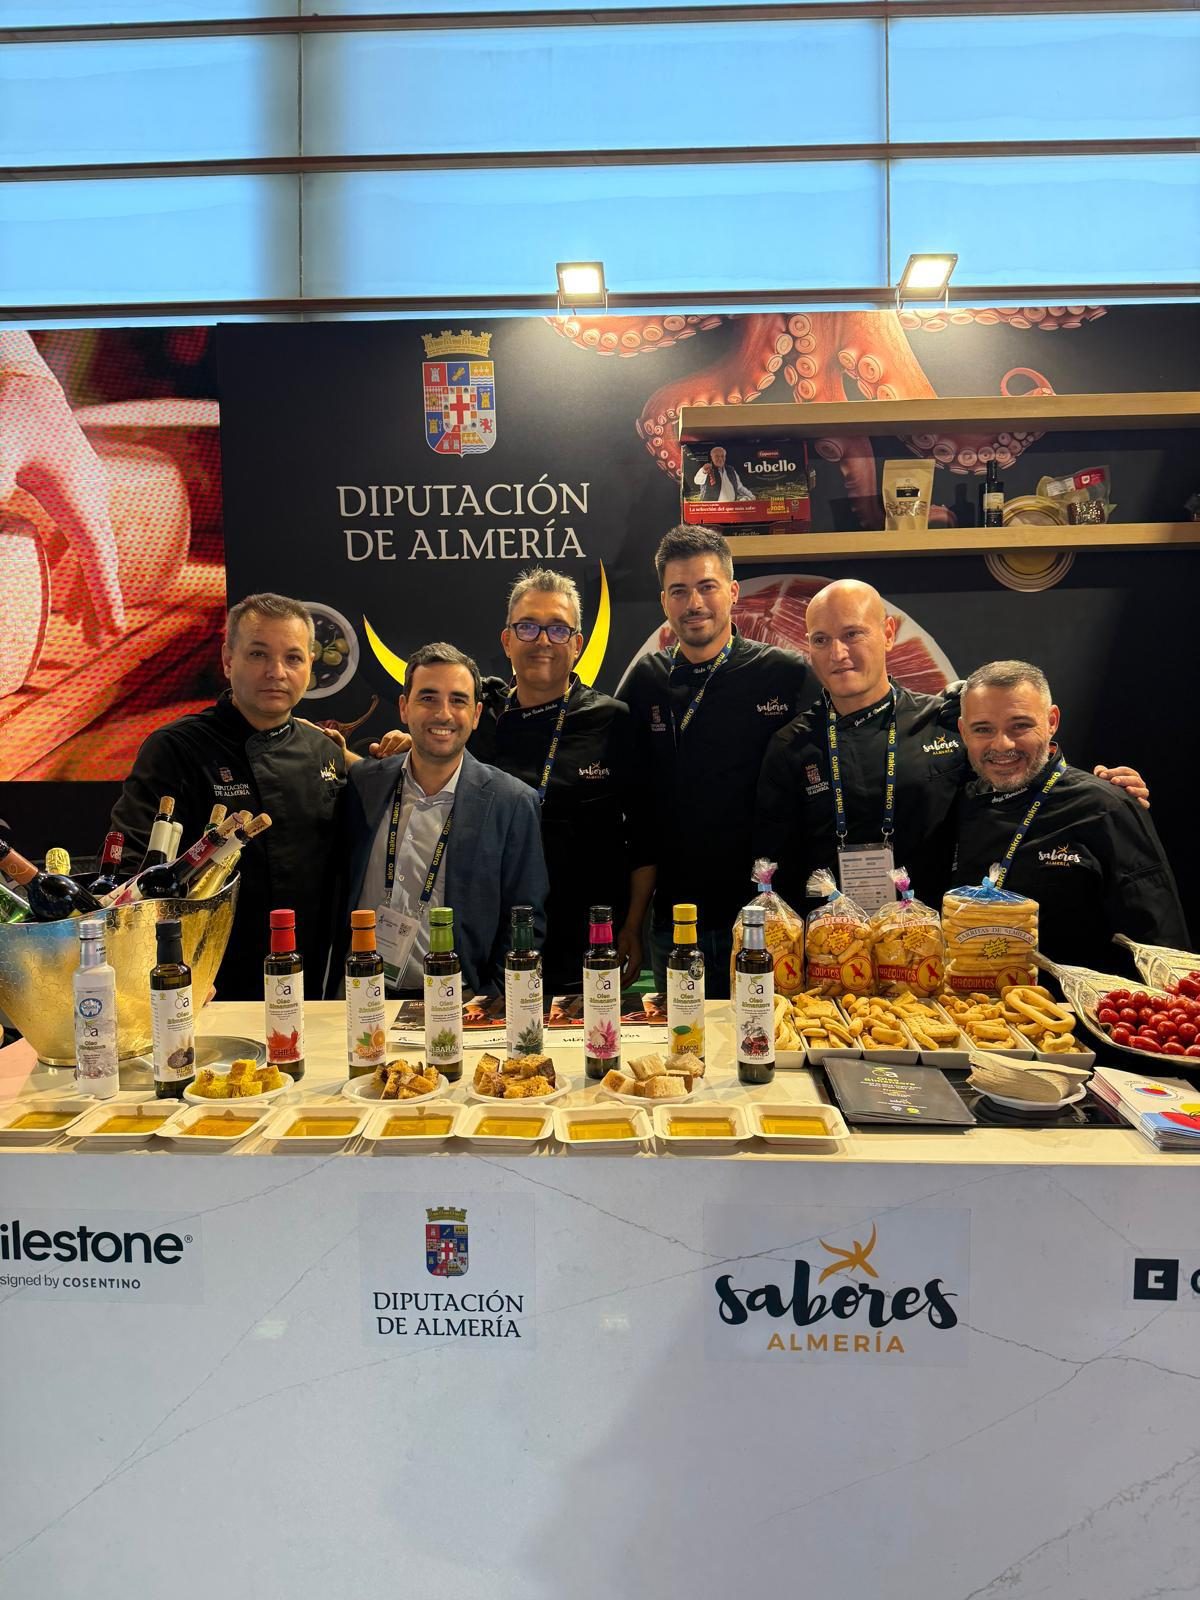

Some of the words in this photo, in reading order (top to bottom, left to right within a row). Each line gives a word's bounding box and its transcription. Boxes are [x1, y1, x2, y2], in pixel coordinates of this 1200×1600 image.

[743, 459, 796, 473] Lobello
[336, 473, 590, 517] DIPUTACIÓN
[343, 529, 397, 562] DE
[408, 518, 587, 560] ALMERÍA
[756, 700, 789, 712] sabores
[556, 708, 566, 731] makro
[680, 708, 695, 730] makro
[548, 737, 559, 759] makro
[828, 724, 837, 749] makro
[922, 739, 960, 753] sabores
[578, 765, 610, 776] sabores
[832, 755, 840, 781] makro
[887, 751, 895, 776] makro
[540, 764, 551, 787] makro
[1041, 771, 1061, 794] makro
[836, 787, 845, 814] makro
[886, 783, 894, 810] makro
[392, 802, 400, 825] makro
[1023, 800, 1041, 827] makro
[388, 831, 396, 855] makro
[432, 841, 444, 866] makro
[1006, 833, 1023, 860] makro
[1038, 848, 1082, 863] sabores
[957, 927, 990, 943] BARRITAS
[878, 968, 917, 981] PRODUCTOS
[952, 977, 995, 989] PRODUCTOS
[676, 1045, 699, 1053] LEMON
[44, 1274, 60, 1289] by
[62, 1276, 141, 1289] COSENTINO
[373, 1290, 524, 1313] DIPUTACIÓN
[714, 1259, 959, 1329] sabores
[377, 1317, 408, 1335] DE
[414, 1315, 522, 1338] ALMERÍA
[767, 1331, 905, 1353] ALMERÍA
